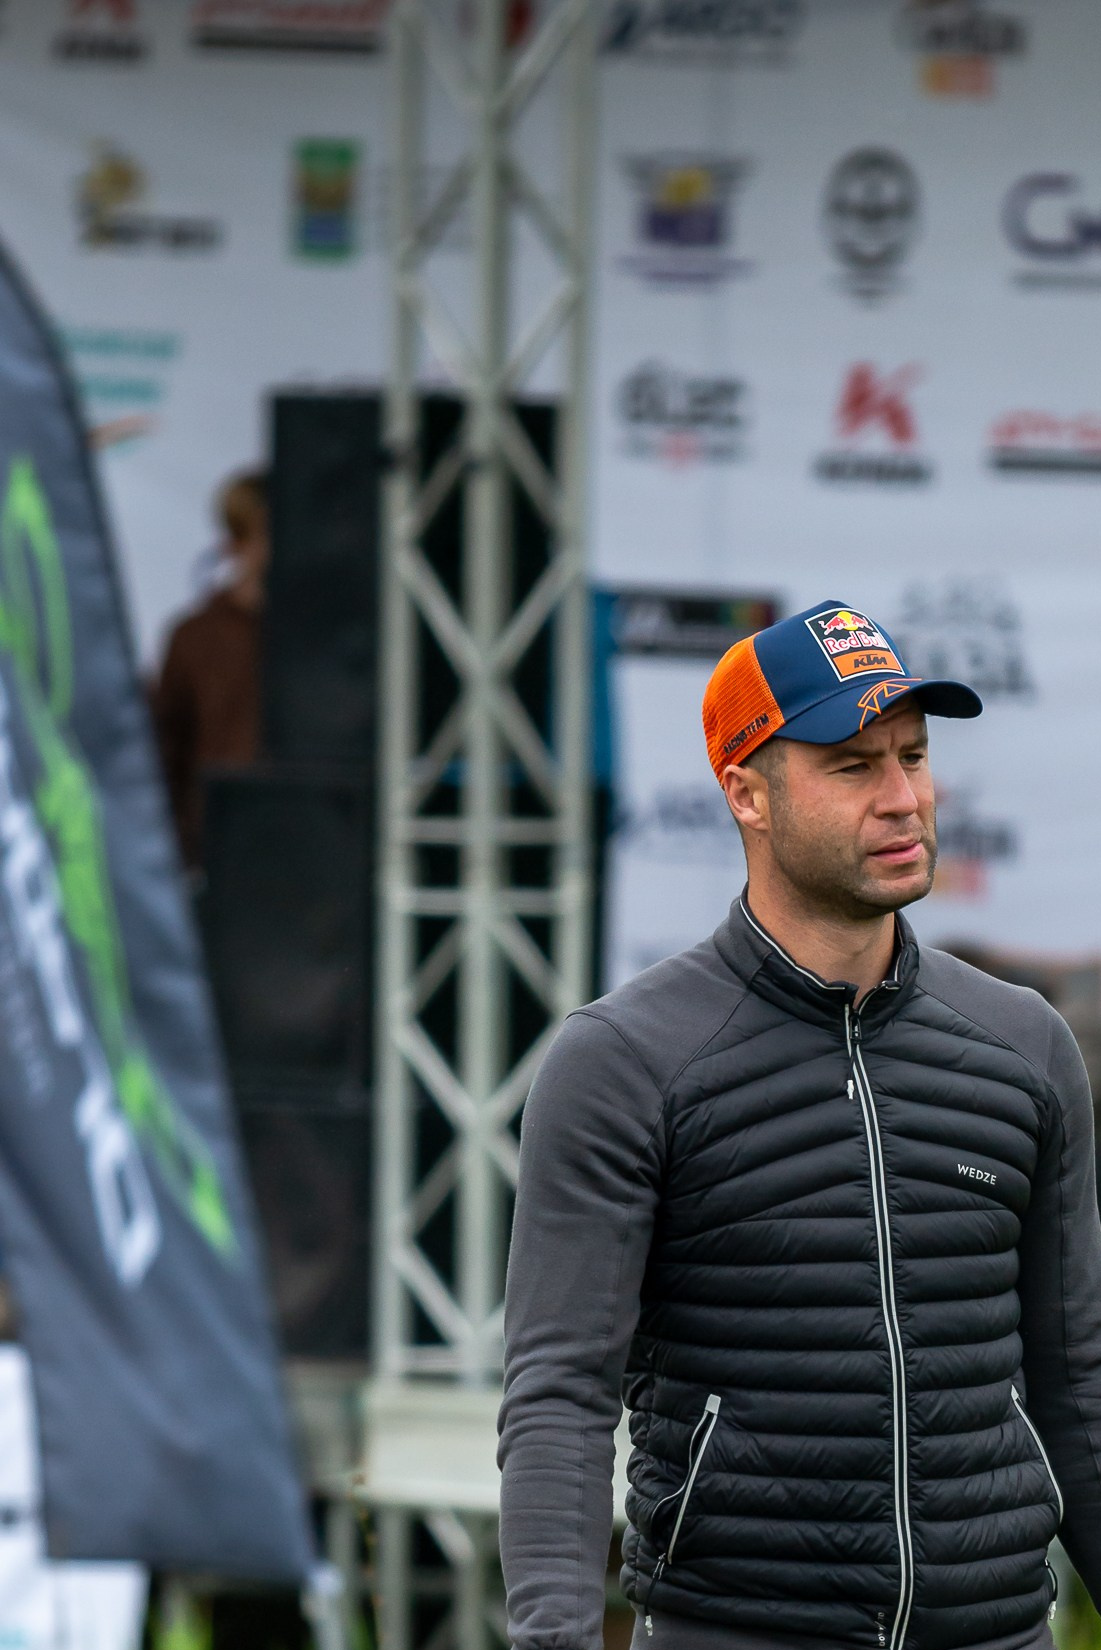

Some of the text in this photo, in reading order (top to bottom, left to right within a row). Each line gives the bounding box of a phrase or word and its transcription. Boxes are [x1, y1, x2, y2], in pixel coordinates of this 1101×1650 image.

[823, 631, 861, 655] Red
[853, 653, 888, 669] KTM
[957, 1163, 997, 1186] WEDZE
